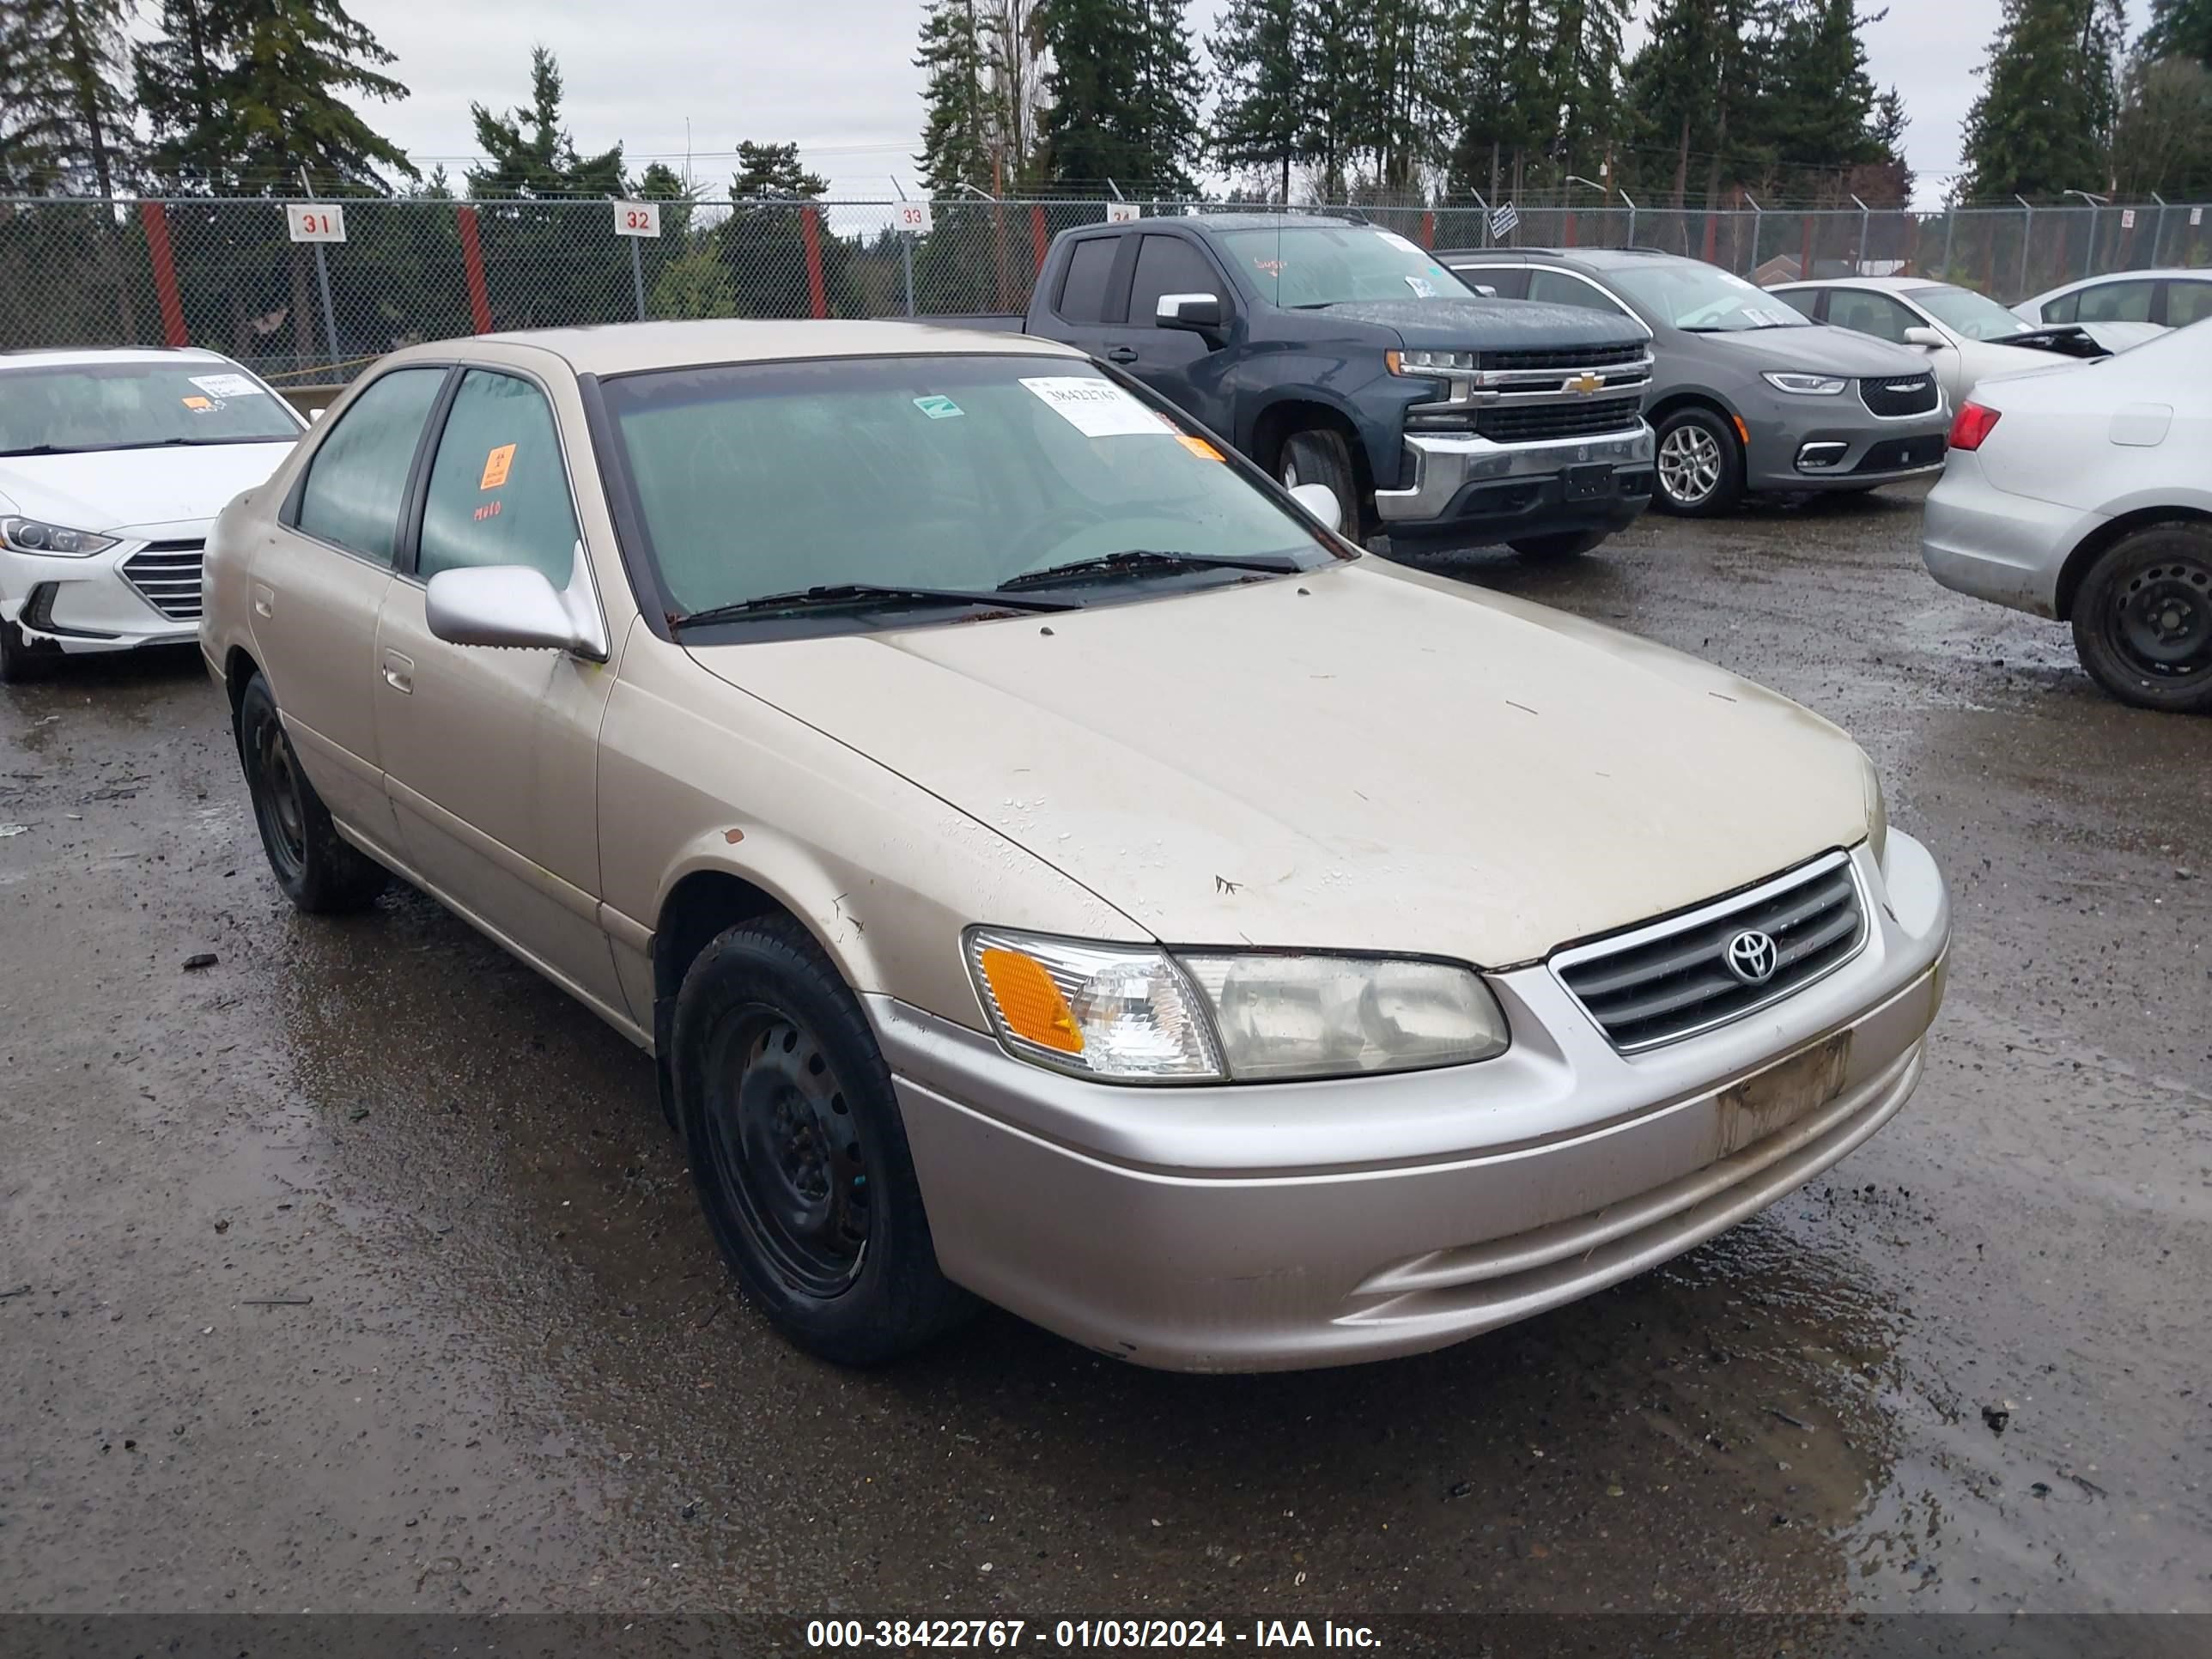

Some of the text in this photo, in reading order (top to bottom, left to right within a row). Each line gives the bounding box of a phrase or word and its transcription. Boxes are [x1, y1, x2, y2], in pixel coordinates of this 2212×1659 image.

[302, 215, 329, 234] 31
[627, 211, 648, 229] 32
[903, 209, 921, 224] 33
[1046, 390, 1121, 401] 38422767
